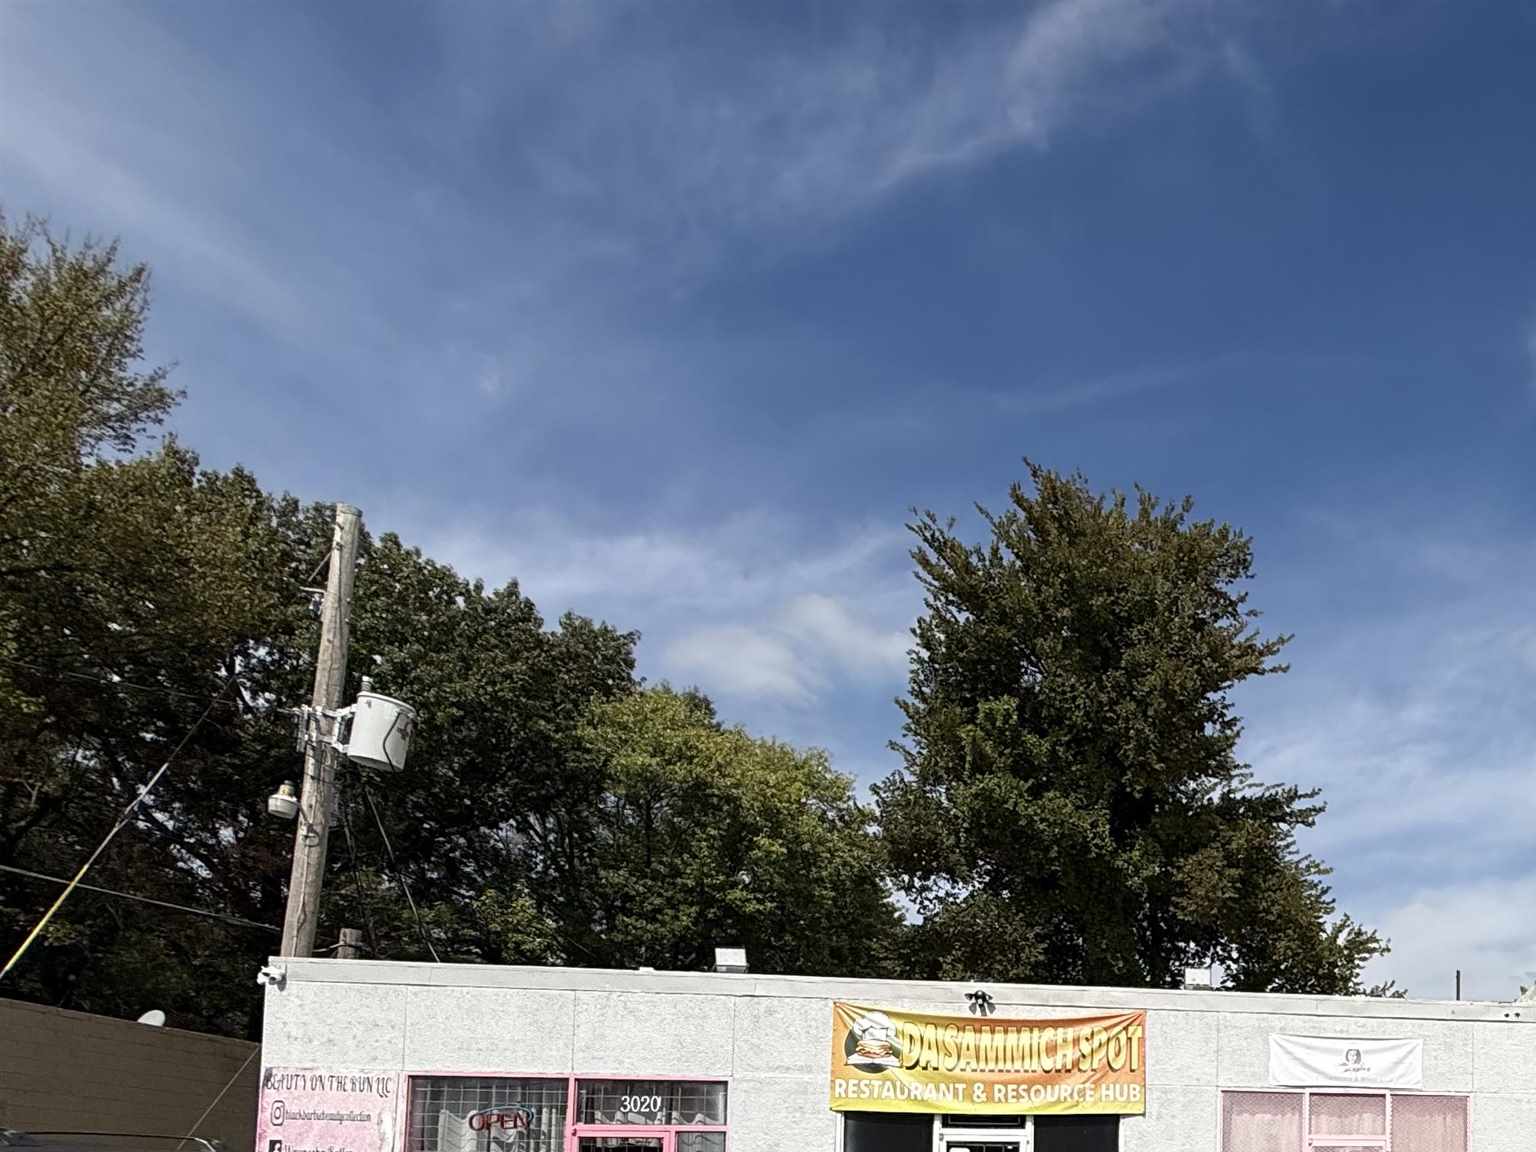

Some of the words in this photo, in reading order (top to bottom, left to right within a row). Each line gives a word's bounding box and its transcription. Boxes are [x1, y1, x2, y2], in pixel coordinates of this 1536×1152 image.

[942, 1023, 1073, 1073] SAMMICH
[1076, 1023, 1143, 1073] SPOT
[264, 1073, 306, 1091] BEAUTY
[310, 1074, 325, 1092] ON
[327, 1075, 348, 1093] THE
[350, 1076, 373, 1093] RUN
[834, 1079, 966, 1103] RESTAURANT
[972, 1082, 987, 1103] &
[992, 1084, 1095, 1104] RESOURCE
[1101, 1083, 1141, 1103] HUB
[620, 1095, 662, 1113] 3020
[469, 1110, 530, 1132] OPEN
